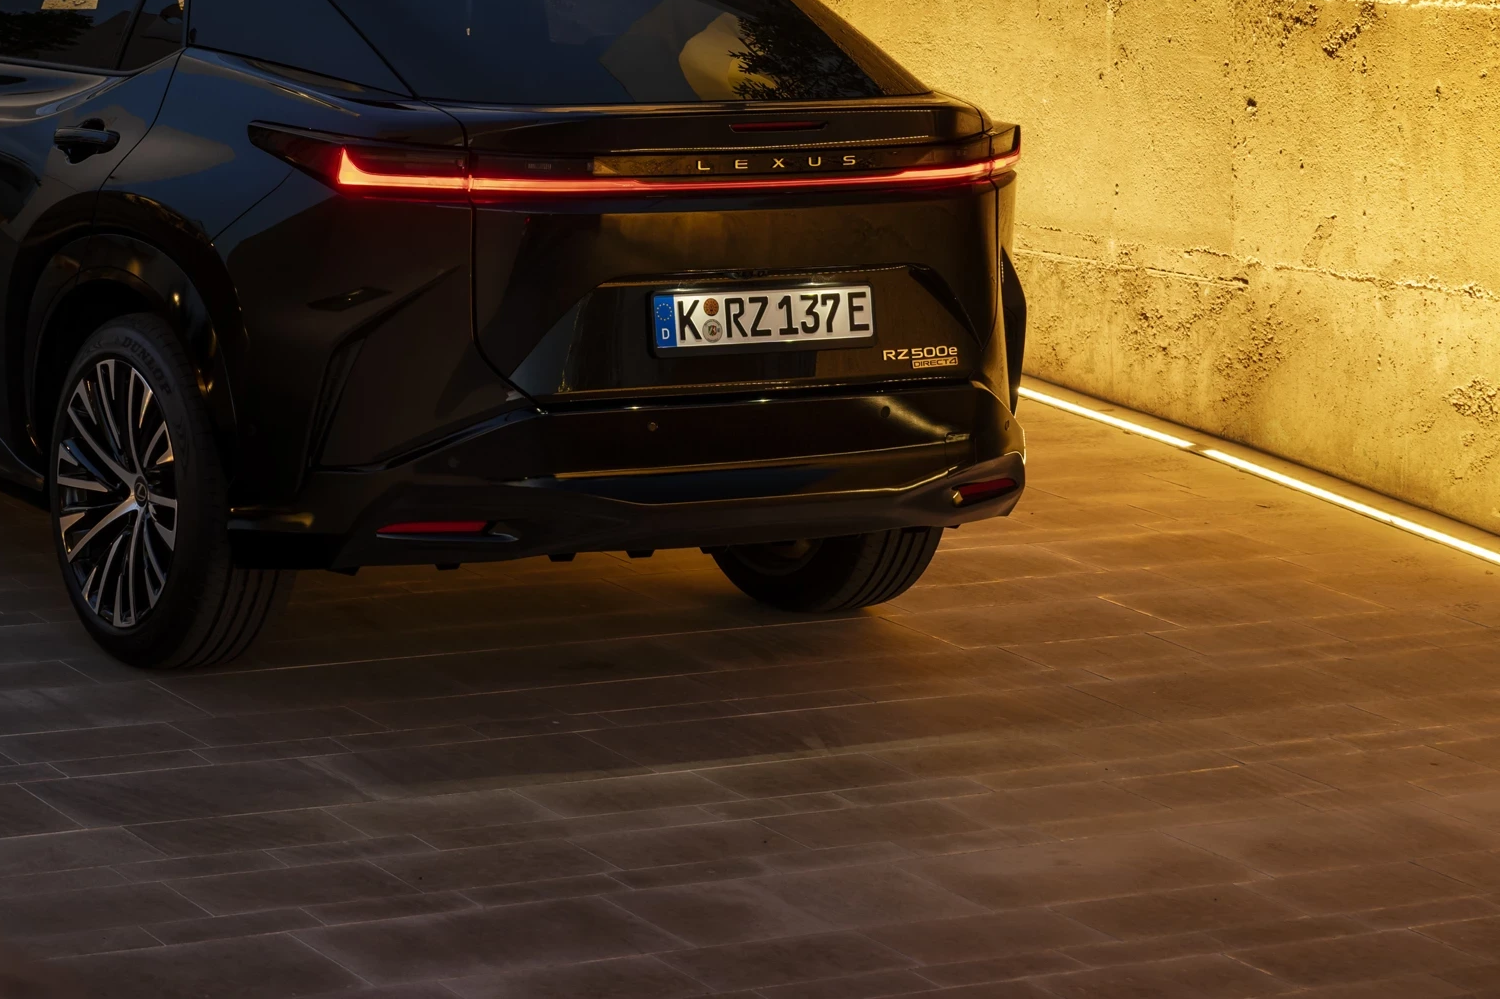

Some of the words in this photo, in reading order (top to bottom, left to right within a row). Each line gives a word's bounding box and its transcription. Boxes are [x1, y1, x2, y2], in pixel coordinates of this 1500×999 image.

[697, 155, 856, 171] LEXUS
[677, 299, 702, 341] K
[661, 328, 671, 340] D
[122, 336, 172, 395] DUNLOP
[913, 357, 958, 369] DIRECT4
